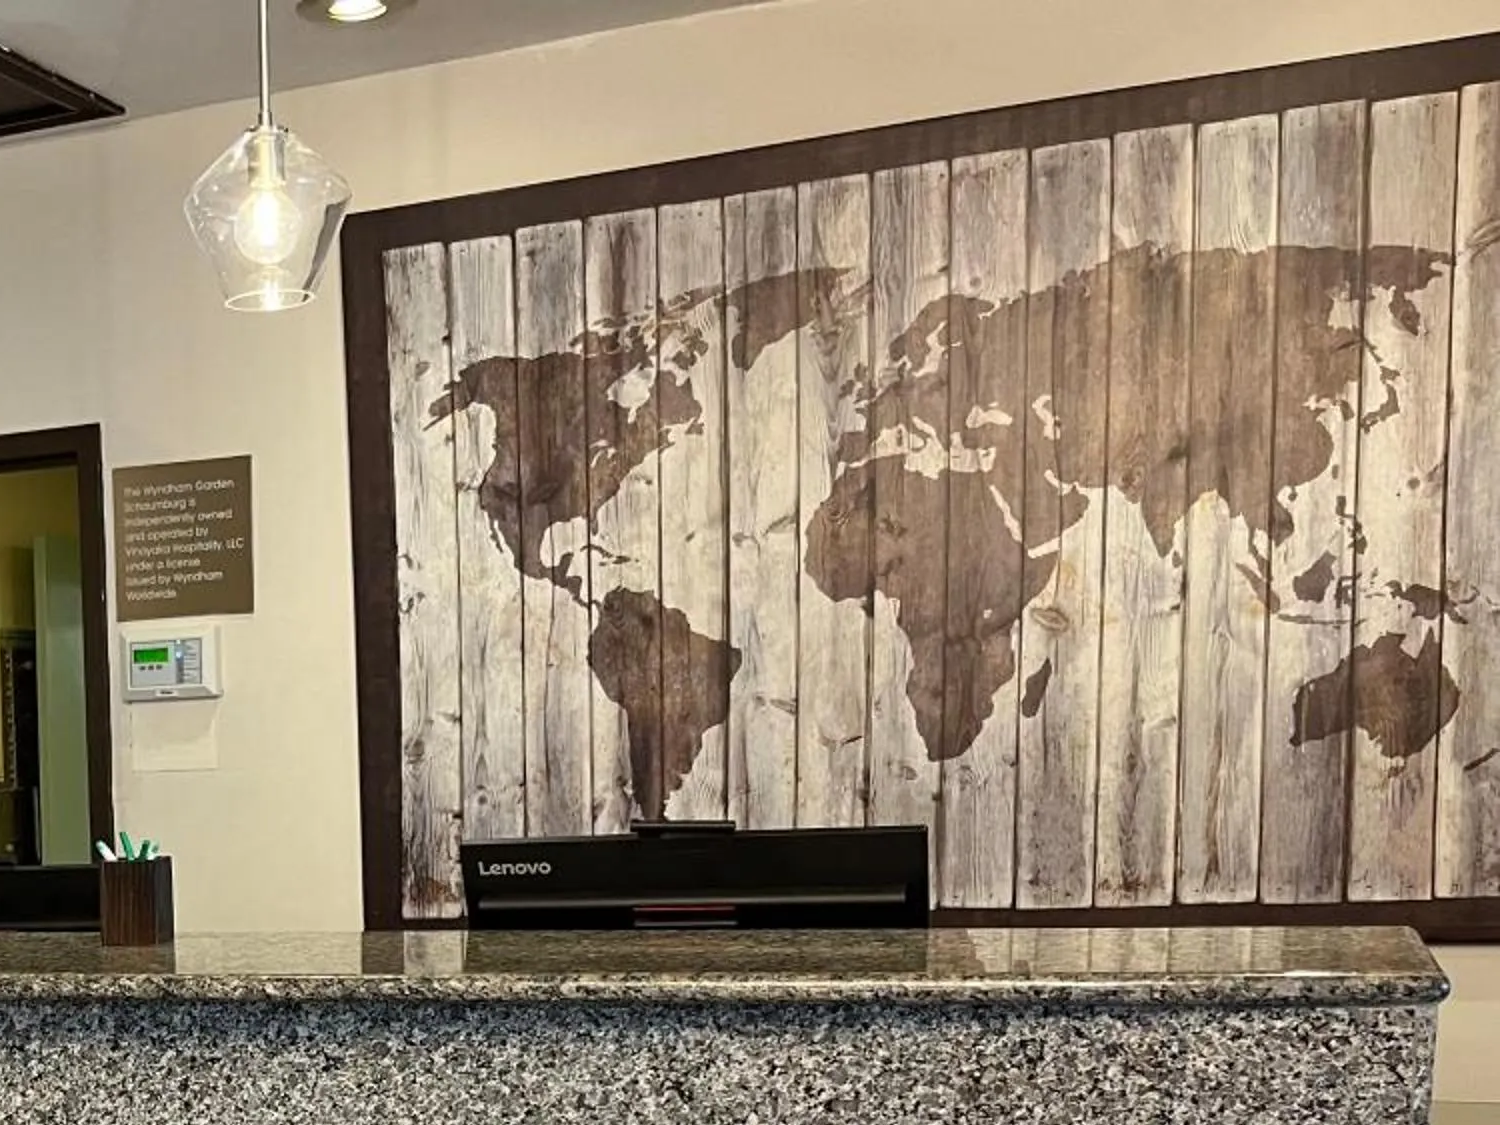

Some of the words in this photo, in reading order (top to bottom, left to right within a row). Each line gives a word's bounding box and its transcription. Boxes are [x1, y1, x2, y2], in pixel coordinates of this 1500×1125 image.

[144, 483, 193, 497] Wyndham
[195, 479, 235, 492] Garden
[124, 499, 187, 513] Schaumburg
[124, 513, 195, 527] independently
[197, 509, 233, 522] owned
[125, 531, 145, 543] and
[147, 528, 194, 542] operated
[195, 527, 209, 538] by
[226, 537, 244, 550] LLC
[125, 560, 154, 573] under
[166, 558, 201, 570] license
[125, 573, 157, 587] issued
[158, 571, 172, 586] by
[173, 570, 224, 585] Wyndham
[125, 588, 177, 602] Worldwide
[478, 859, 552, 876] Lenovo
